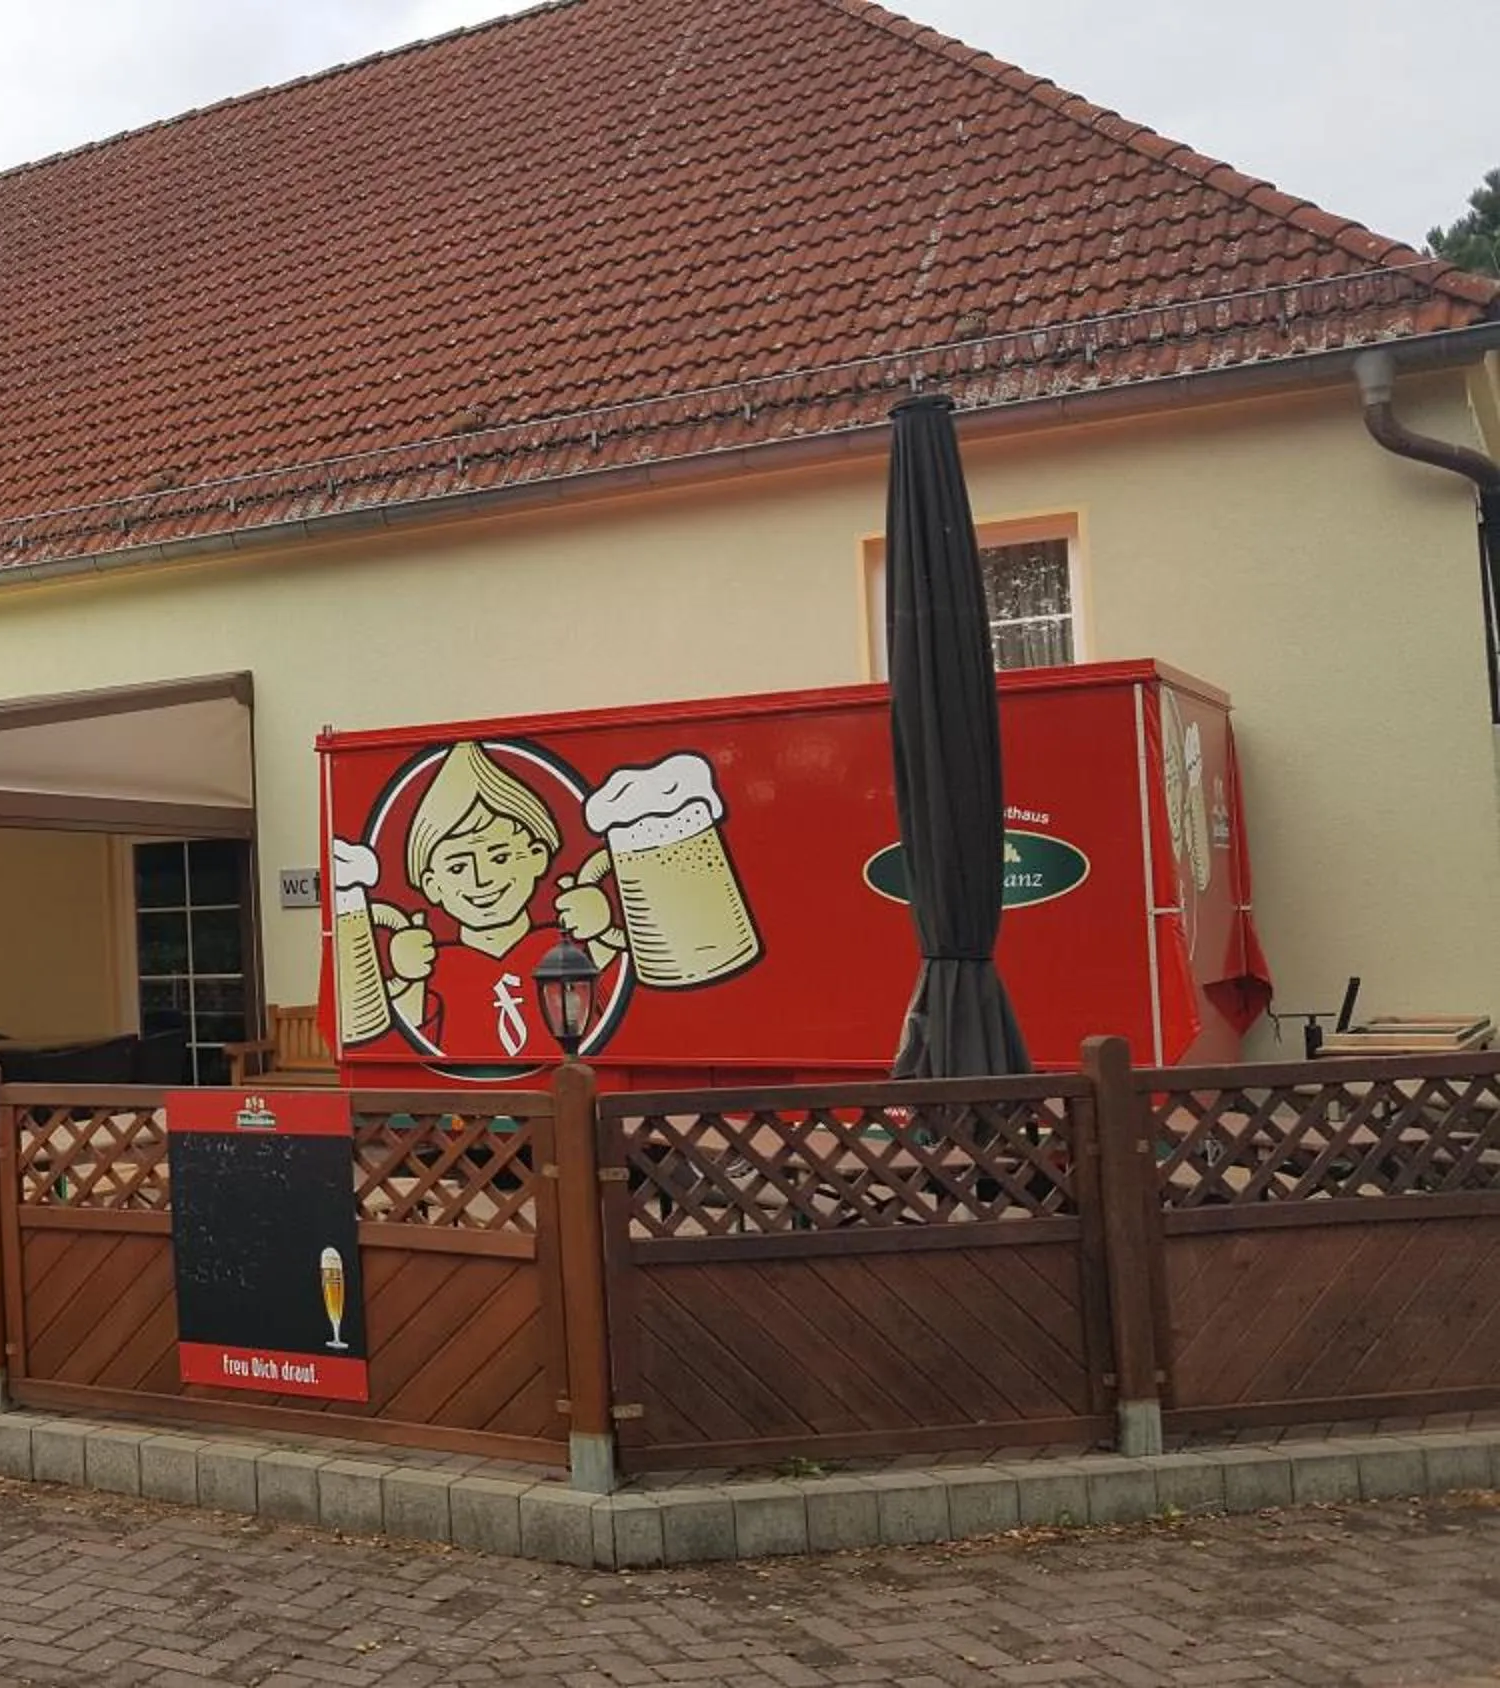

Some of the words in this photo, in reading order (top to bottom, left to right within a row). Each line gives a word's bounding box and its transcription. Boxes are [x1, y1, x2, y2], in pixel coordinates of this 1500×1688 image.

[1003, 805, 1050, 824] thaus
[283, 879, 309, 895] WC
[251, 1357, 279, 1380] Dich
